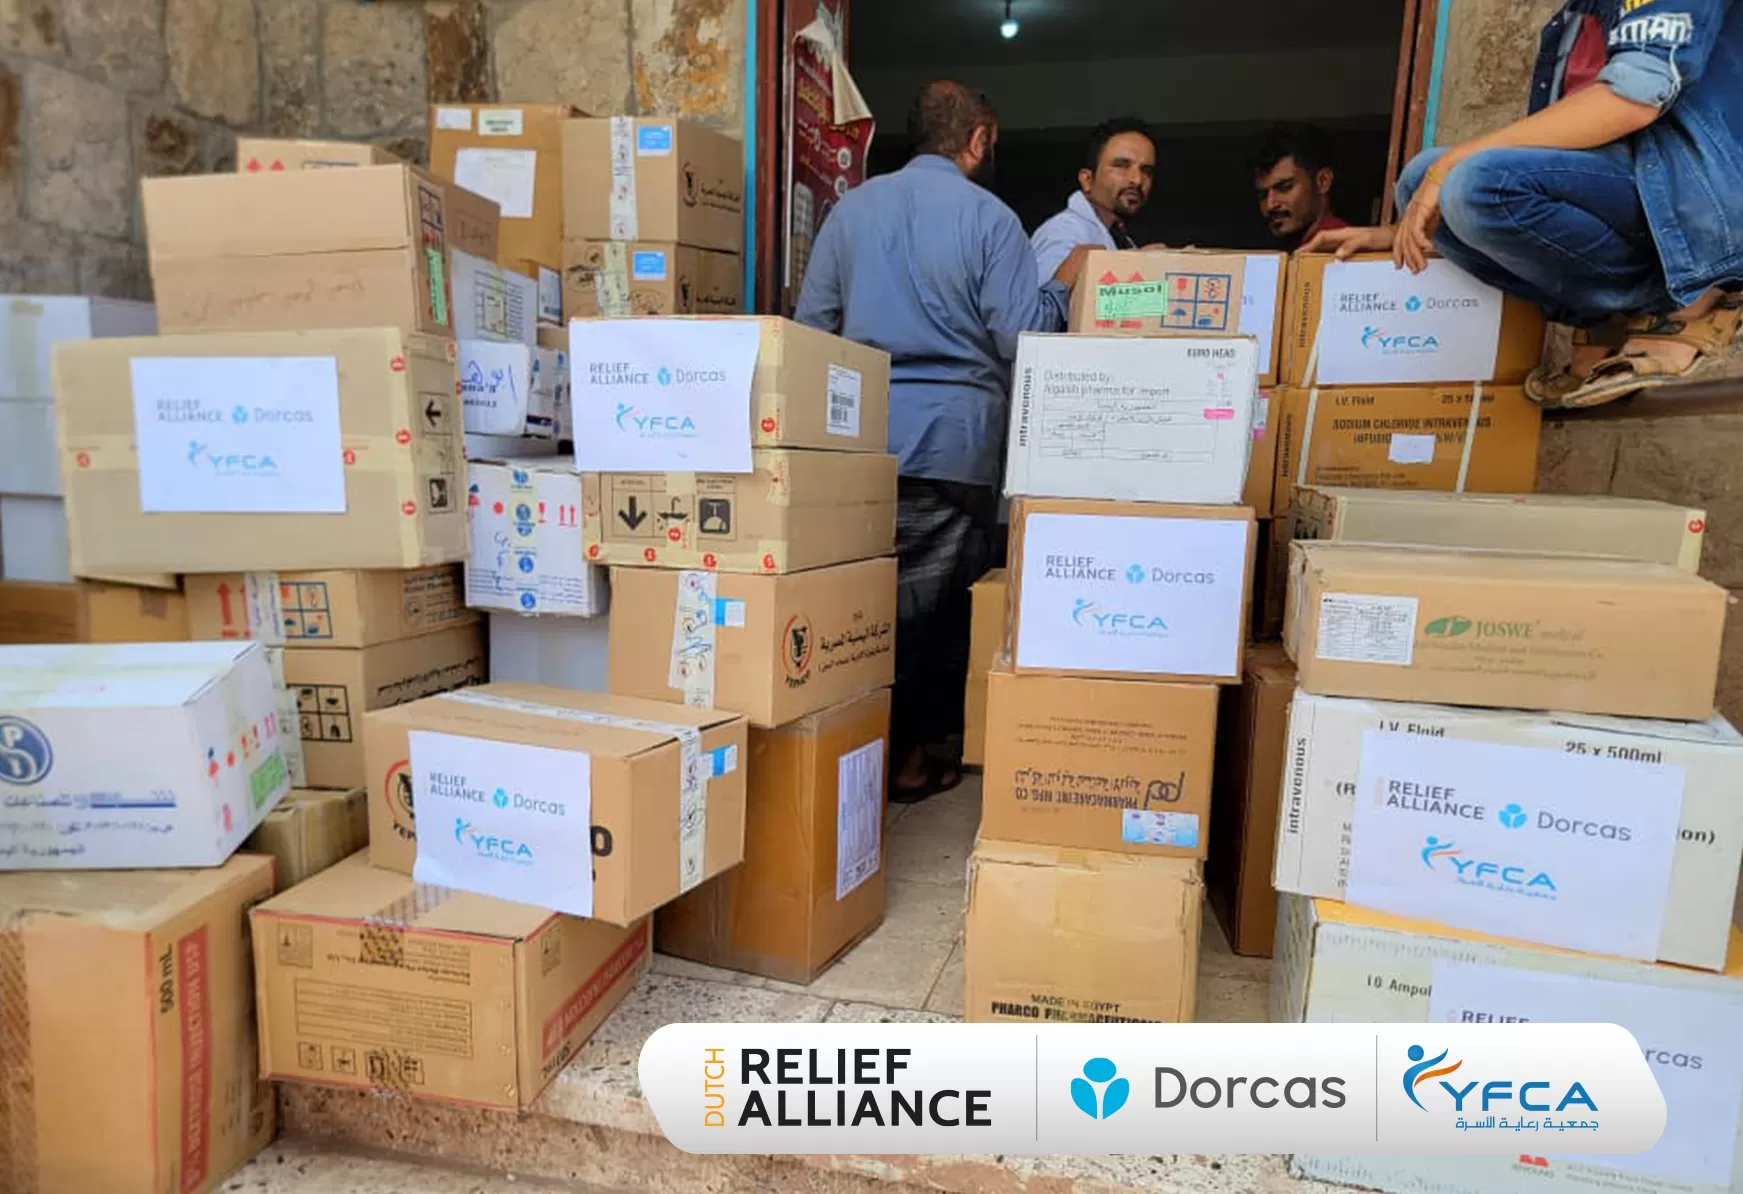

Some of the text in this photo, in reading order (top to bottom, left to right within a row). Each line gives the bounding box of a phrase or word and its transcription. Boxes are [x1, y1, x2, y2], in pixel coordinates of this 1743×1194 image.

[1338, 296, 1481, 313] ALLIANCE Dorcas
[1339, 292, 1380, 302] RELIEF
[1379, 335, 1440, 348] YFCA
[589, 362, 631, 374] RELIEF
[589, 368, 727, 386] ALLIANCE Dorcas
[157, 408, 314, 423] ALLIANCE Dorcas
[632, 416, 696, 430] YFCA
[1423, 416, 1492, 429] INTRAVENUS
[208, 454, 279, 470] YFCA
[1045, 554, 1096, 568] RELIEF
[1045, 567, 1216, 585] ALLIANCE Dorcas
[1092, 613, 1169, 631] YFCA
[429, 772, 467, 788] RELIEF
[1287, 738, 1307, 834] intravenous
[1388, 779, 1456, 801] RELIEF
[430, 783, 566, 817] ALLIANCE Dorcas
[1386, 793, 1633, 843] ALLIANCE Dorcas
[471, 834, 533, 858] YFCA
[1448, 856, 1557, 891] YFCA
[1366, 974, 1383, 989] 10
[1030, 993, 1064, 1007] MADE
[991, 1001, 1040, 1019] PHARCO
[1645, 1047, 1704, 1070] rcas
